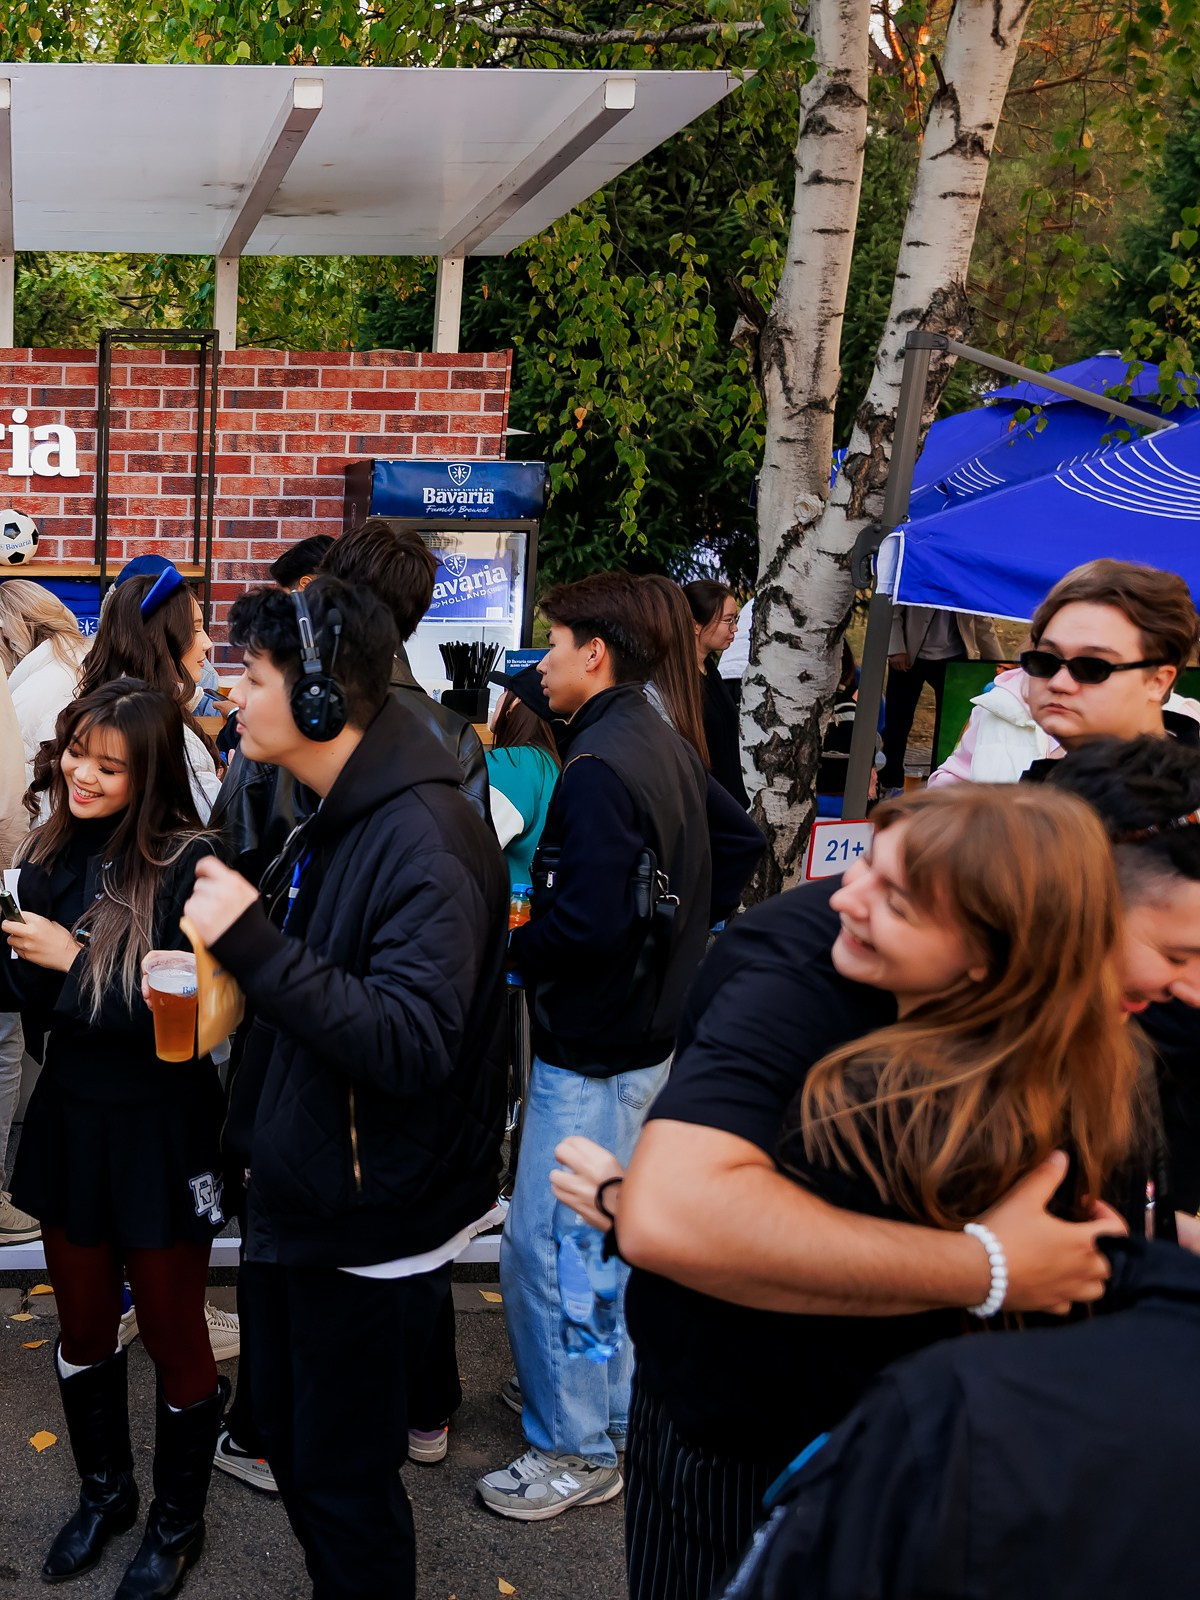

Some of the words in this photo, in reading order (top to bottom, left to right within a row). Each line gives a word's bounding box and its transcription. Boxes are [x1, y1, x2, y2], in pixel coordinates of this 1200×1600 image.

[422, 487, 495, 505] Bavaria
[425, 504, 456, 516] Family
[457, 505, 490, 514] Brewed
[5, 540, 32, 552] Bavaria
[440, 589, 487, 607] HOLLAND
[824, 838, 865, 862] 21+
